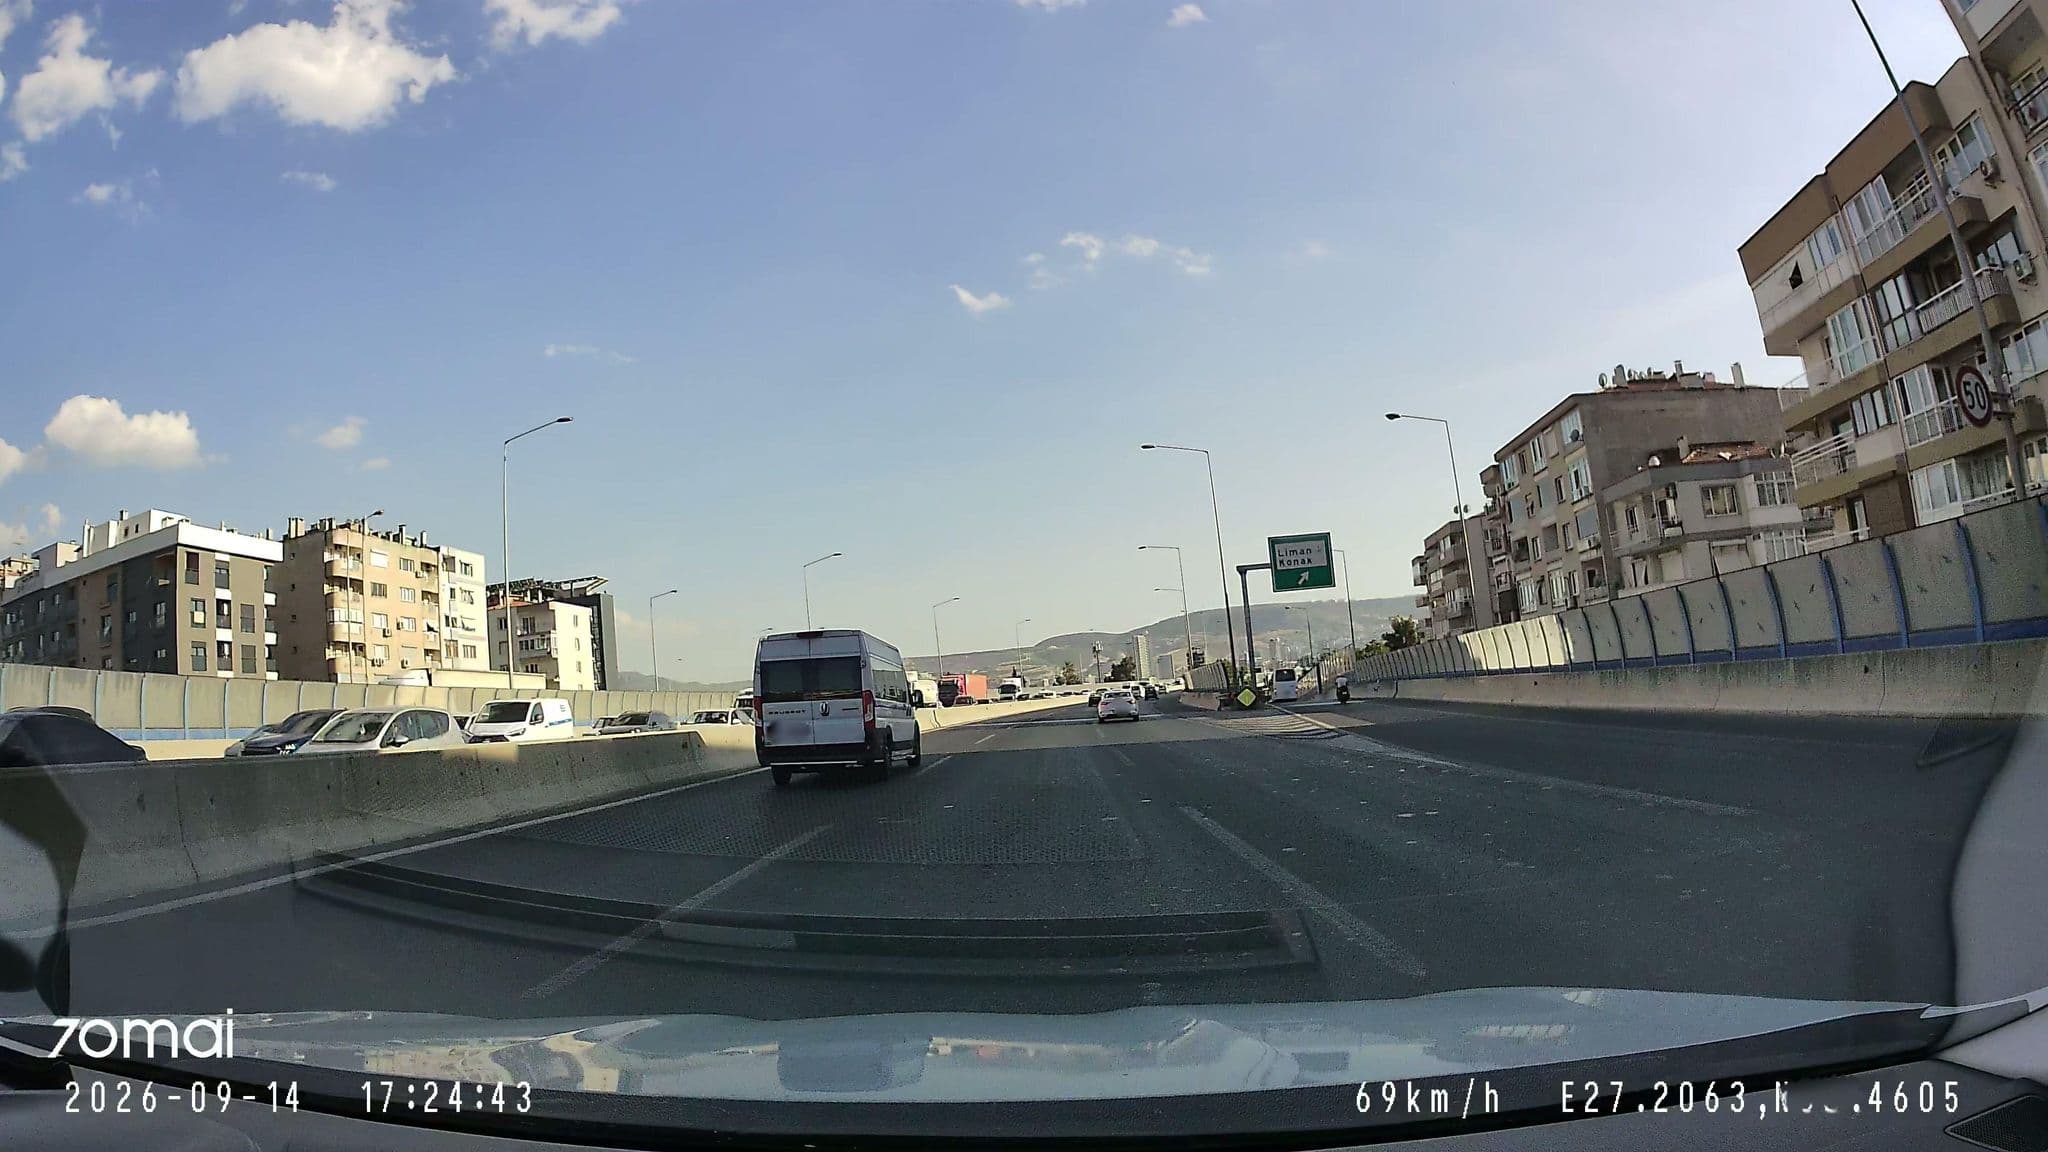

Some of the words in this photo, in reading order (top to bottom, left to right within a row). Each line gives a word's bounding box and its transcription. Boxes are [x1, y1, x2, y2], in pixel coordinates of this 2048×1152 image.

[1962, 380, 1987, 410] 50
[1278, 548, 1312, 557] Liman
[1279, 557, 1313, 567] Konak
